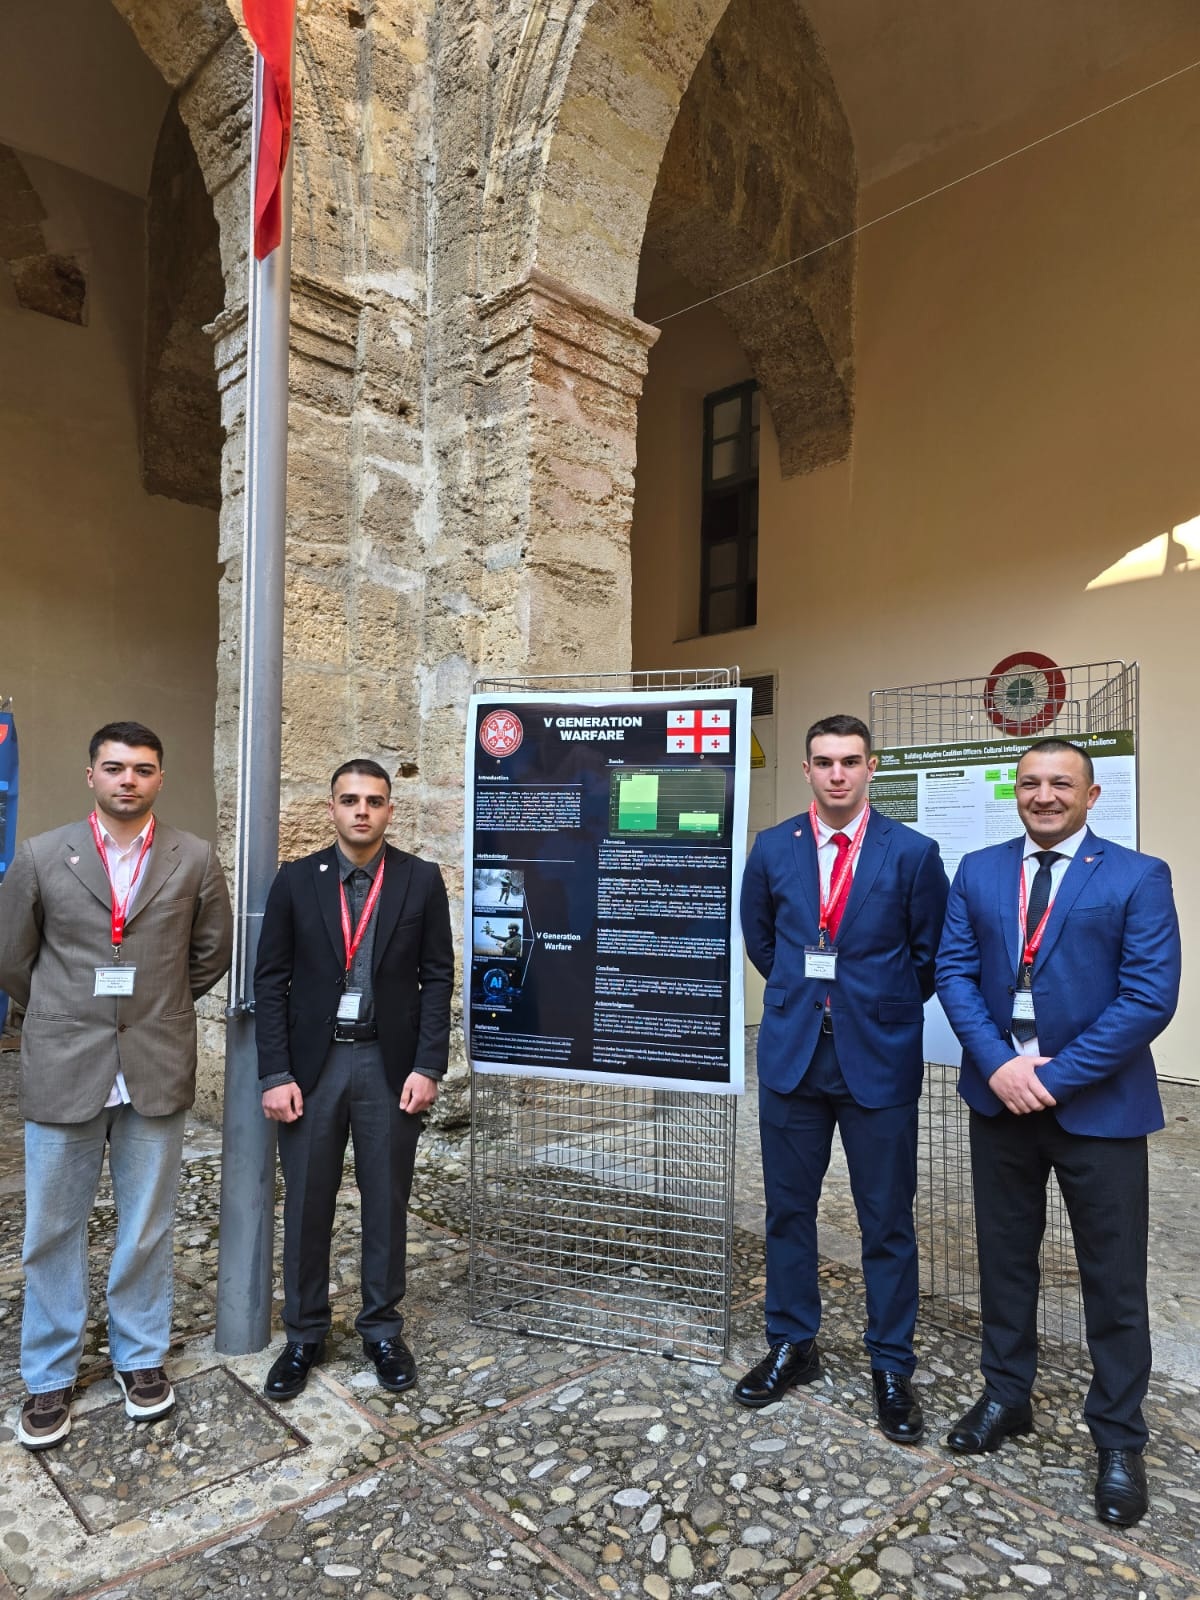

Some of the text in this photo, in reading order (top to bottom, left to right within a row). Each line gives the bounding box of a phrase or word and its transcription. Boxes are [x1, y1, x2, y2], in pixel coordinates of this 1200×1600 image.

[543, 716, 643, 728] V GENERATION
[560, 730, 624, 741] WARFARE
[536, 932, 581, 941] V Generation
[544, 942, 572, 951] Warfare
